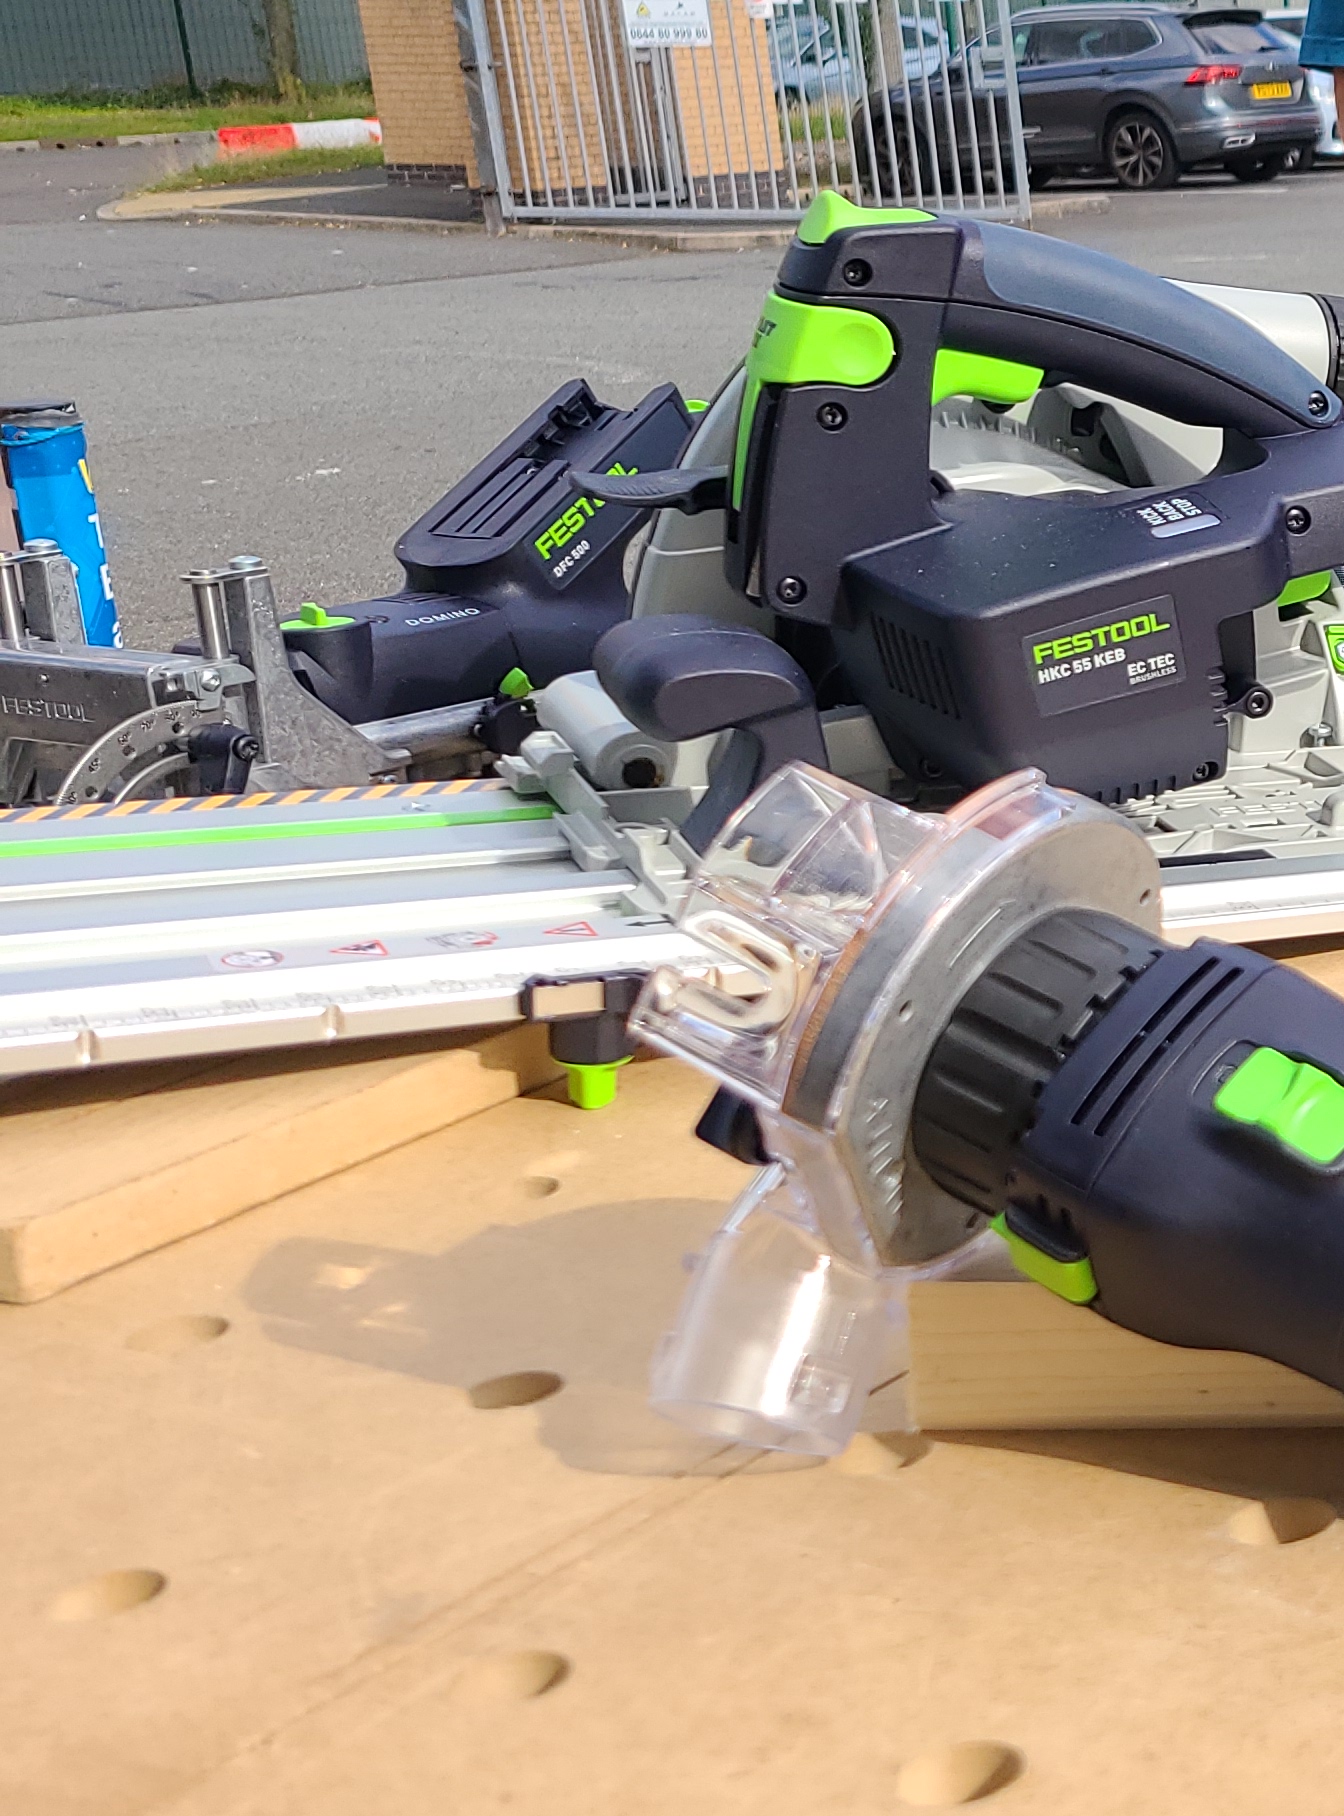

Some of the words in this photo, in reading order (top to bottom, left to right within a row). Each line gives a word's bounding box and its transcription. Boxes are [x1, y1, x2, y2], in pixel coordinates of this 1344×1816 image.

[1136, 507, 1167, 526] KICK
[1152, 501, 1185, 521] BACK
[1171, 498, 1202, 516] STOP
[553, 556, 575, 577] DFC
[571, 540, 591, 560] 500
[405, 608, 480, 626] DOMINO
[1032, 613, 1170, 665] FESTOOL
[1038, 664, 1072, 684] HKC
[1072, 657, 1093, 673] 55
[1093, 648, 1126, 668] KEB
[1127, 661, 1147, 677] EC
[1148, 653, 1176, 670] TEC
[1129, 666, 1177, 685] BRUSHLESS
[1, 695, 96, 723] FESTOOL
